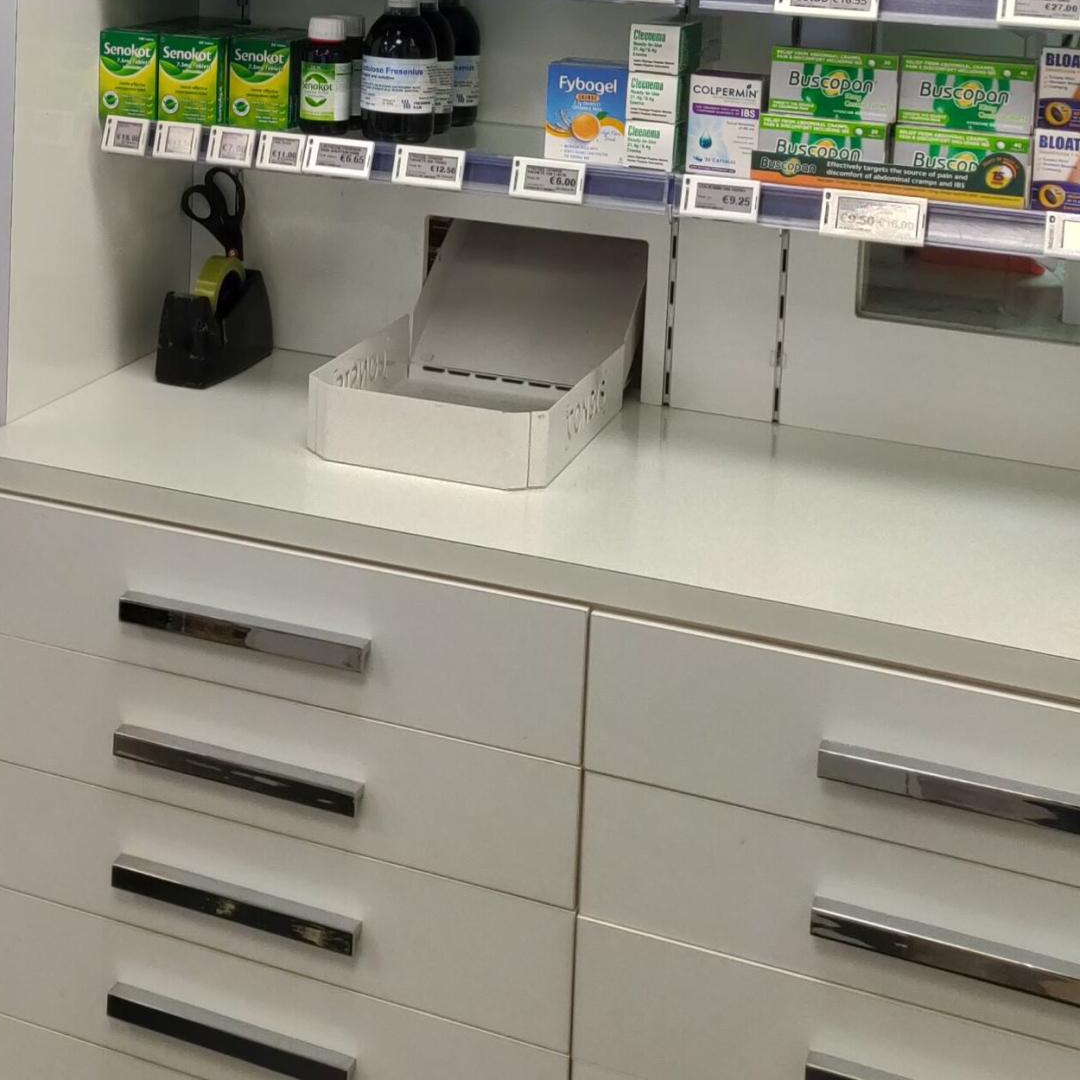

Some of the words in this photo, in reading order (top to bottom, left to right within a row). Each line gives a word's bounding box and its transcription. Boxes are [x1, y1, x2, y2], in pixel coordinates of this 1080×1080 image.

[104, 42, 151, 59] Senokot
[163, 47, 213, 62] Senokot
[234, 48, 285, 65] Senokot
[559, 75, 617, 94] Fybogel
[788, 70, 874, 93] Buscopan
[692, 83, 758, 99] COLPERMIN
[919, 81, 1010, 104] Buscopan
[740, 109, 756, 119] IBS
[760, 156, 817, 175] Buscopan
[826, 160, 863, 171] Effectively
[863, 164, 889, 174] targets
[890, 166, 902, 174] the
[903, 169, 928, 178] source
[928, 170, 937, 178] of
[937, 171, 954, 181] pain
[954, 173, 969, 182] and
[549, 175, 576, 188] €6.00
[825, 168, 864, 179] discomfort
[864, 172, 873, 180] of
[873, 172, 910, 183] abdominal
[911, 178, 938, 188] cramps
[938, 179, 953, 188] and
[953, 180, 966, 189] IBS
[722, 194, 751, 207] €9.25
[840, 212, 875, 226] €9.50
